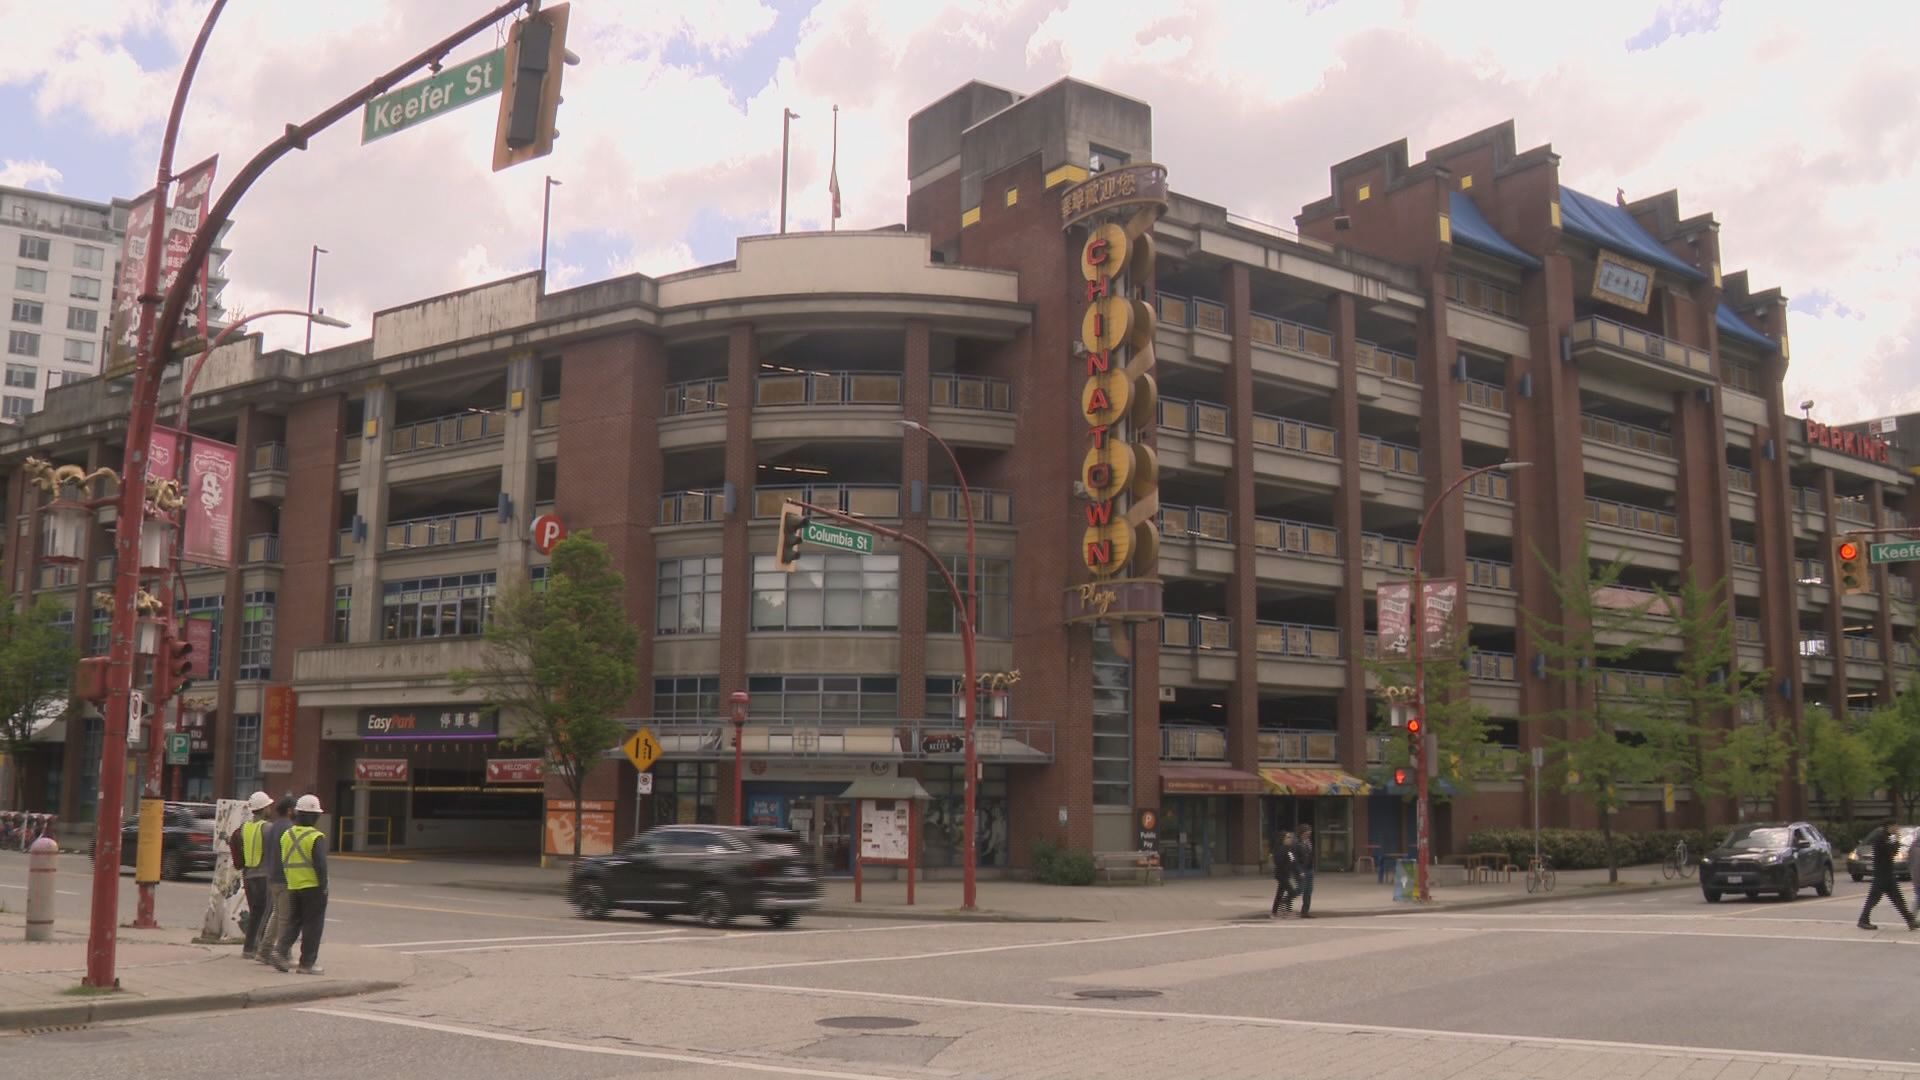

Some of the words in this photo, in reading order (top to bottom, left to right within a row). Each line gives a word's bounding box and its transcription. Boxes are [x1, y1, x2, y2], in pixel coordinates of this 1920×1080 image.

[373, 82, 455, 132] Keefer
[464, 61, 493, 96] St
[1086, 238, 1113, 567] CHINATOWN
[1807, 420, 1888, 464] PARKING
[542, 521, 560, 548] P
[808, 526, 853, 547] Columbia
[856, 535, 868, 550] St
[1080, 583, 1117, 616] Plaza
[368, 714, 416, 733] EasyPark
[173, 737, 187, 753] P
